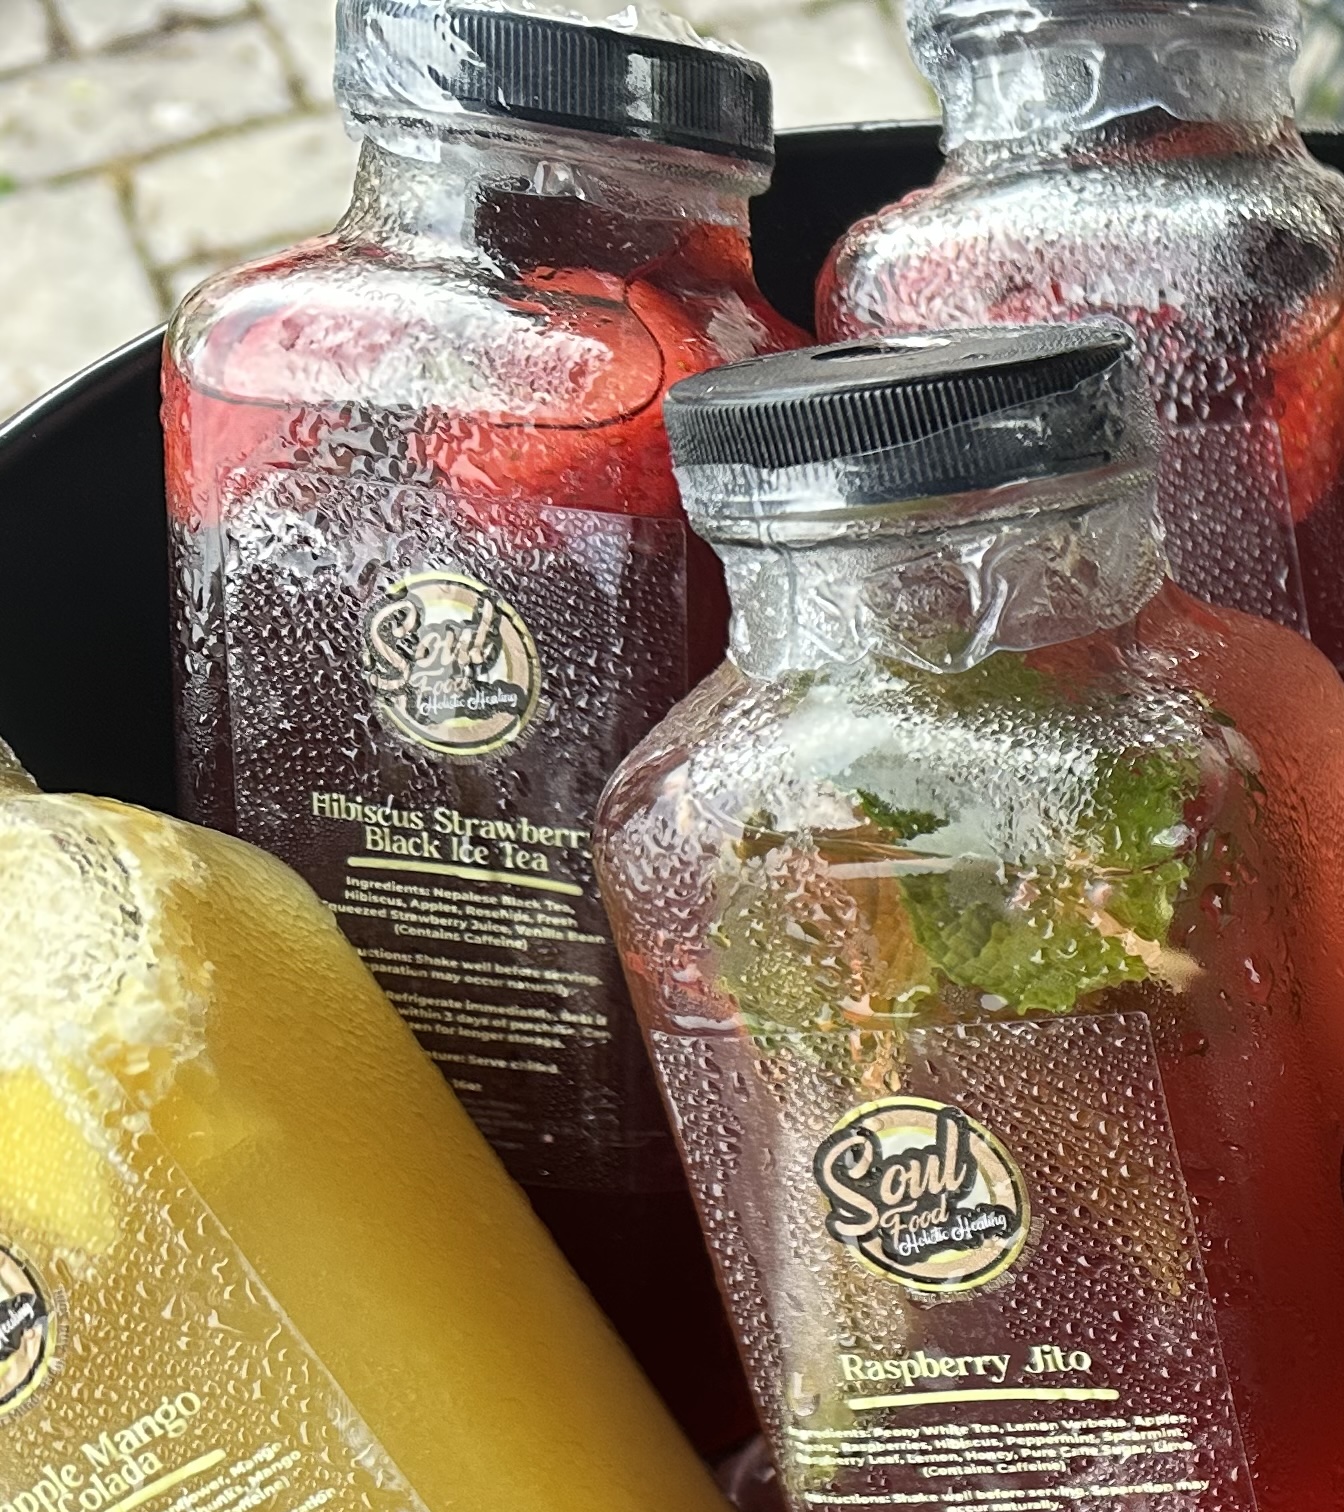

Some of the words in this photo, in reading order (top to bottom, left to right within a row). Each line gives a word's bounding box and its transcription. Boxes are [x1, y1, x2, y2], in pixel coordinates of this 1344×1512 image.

[368, 598, 496, 691] Soul
[312, 792, 425, 829] Hibiscus
[365, 826, 441, 858] Black
[451, 835, 489, 865] Ice
[499, 841, 549, 872] Tea
[346, 876, 430, 896] Ingredients:
[394, 923, 461, 941] (Contains
[822, 1116, 968, 1238] Soul
[880, 1194, 950, 1248] Food
[898, 1225, 949, 1257] Holistic
[951, 1211, 1008, 1242] Healing
[839, 1351, 1008, 1390] Raspberry
[1025, 1344, 1092, 1379] Jito
[80, 1391, 201, 1474] Mango
[922, 1463, 994, 1478] (Contains
[996, 1457, 1067, 1473] Caffeine)
